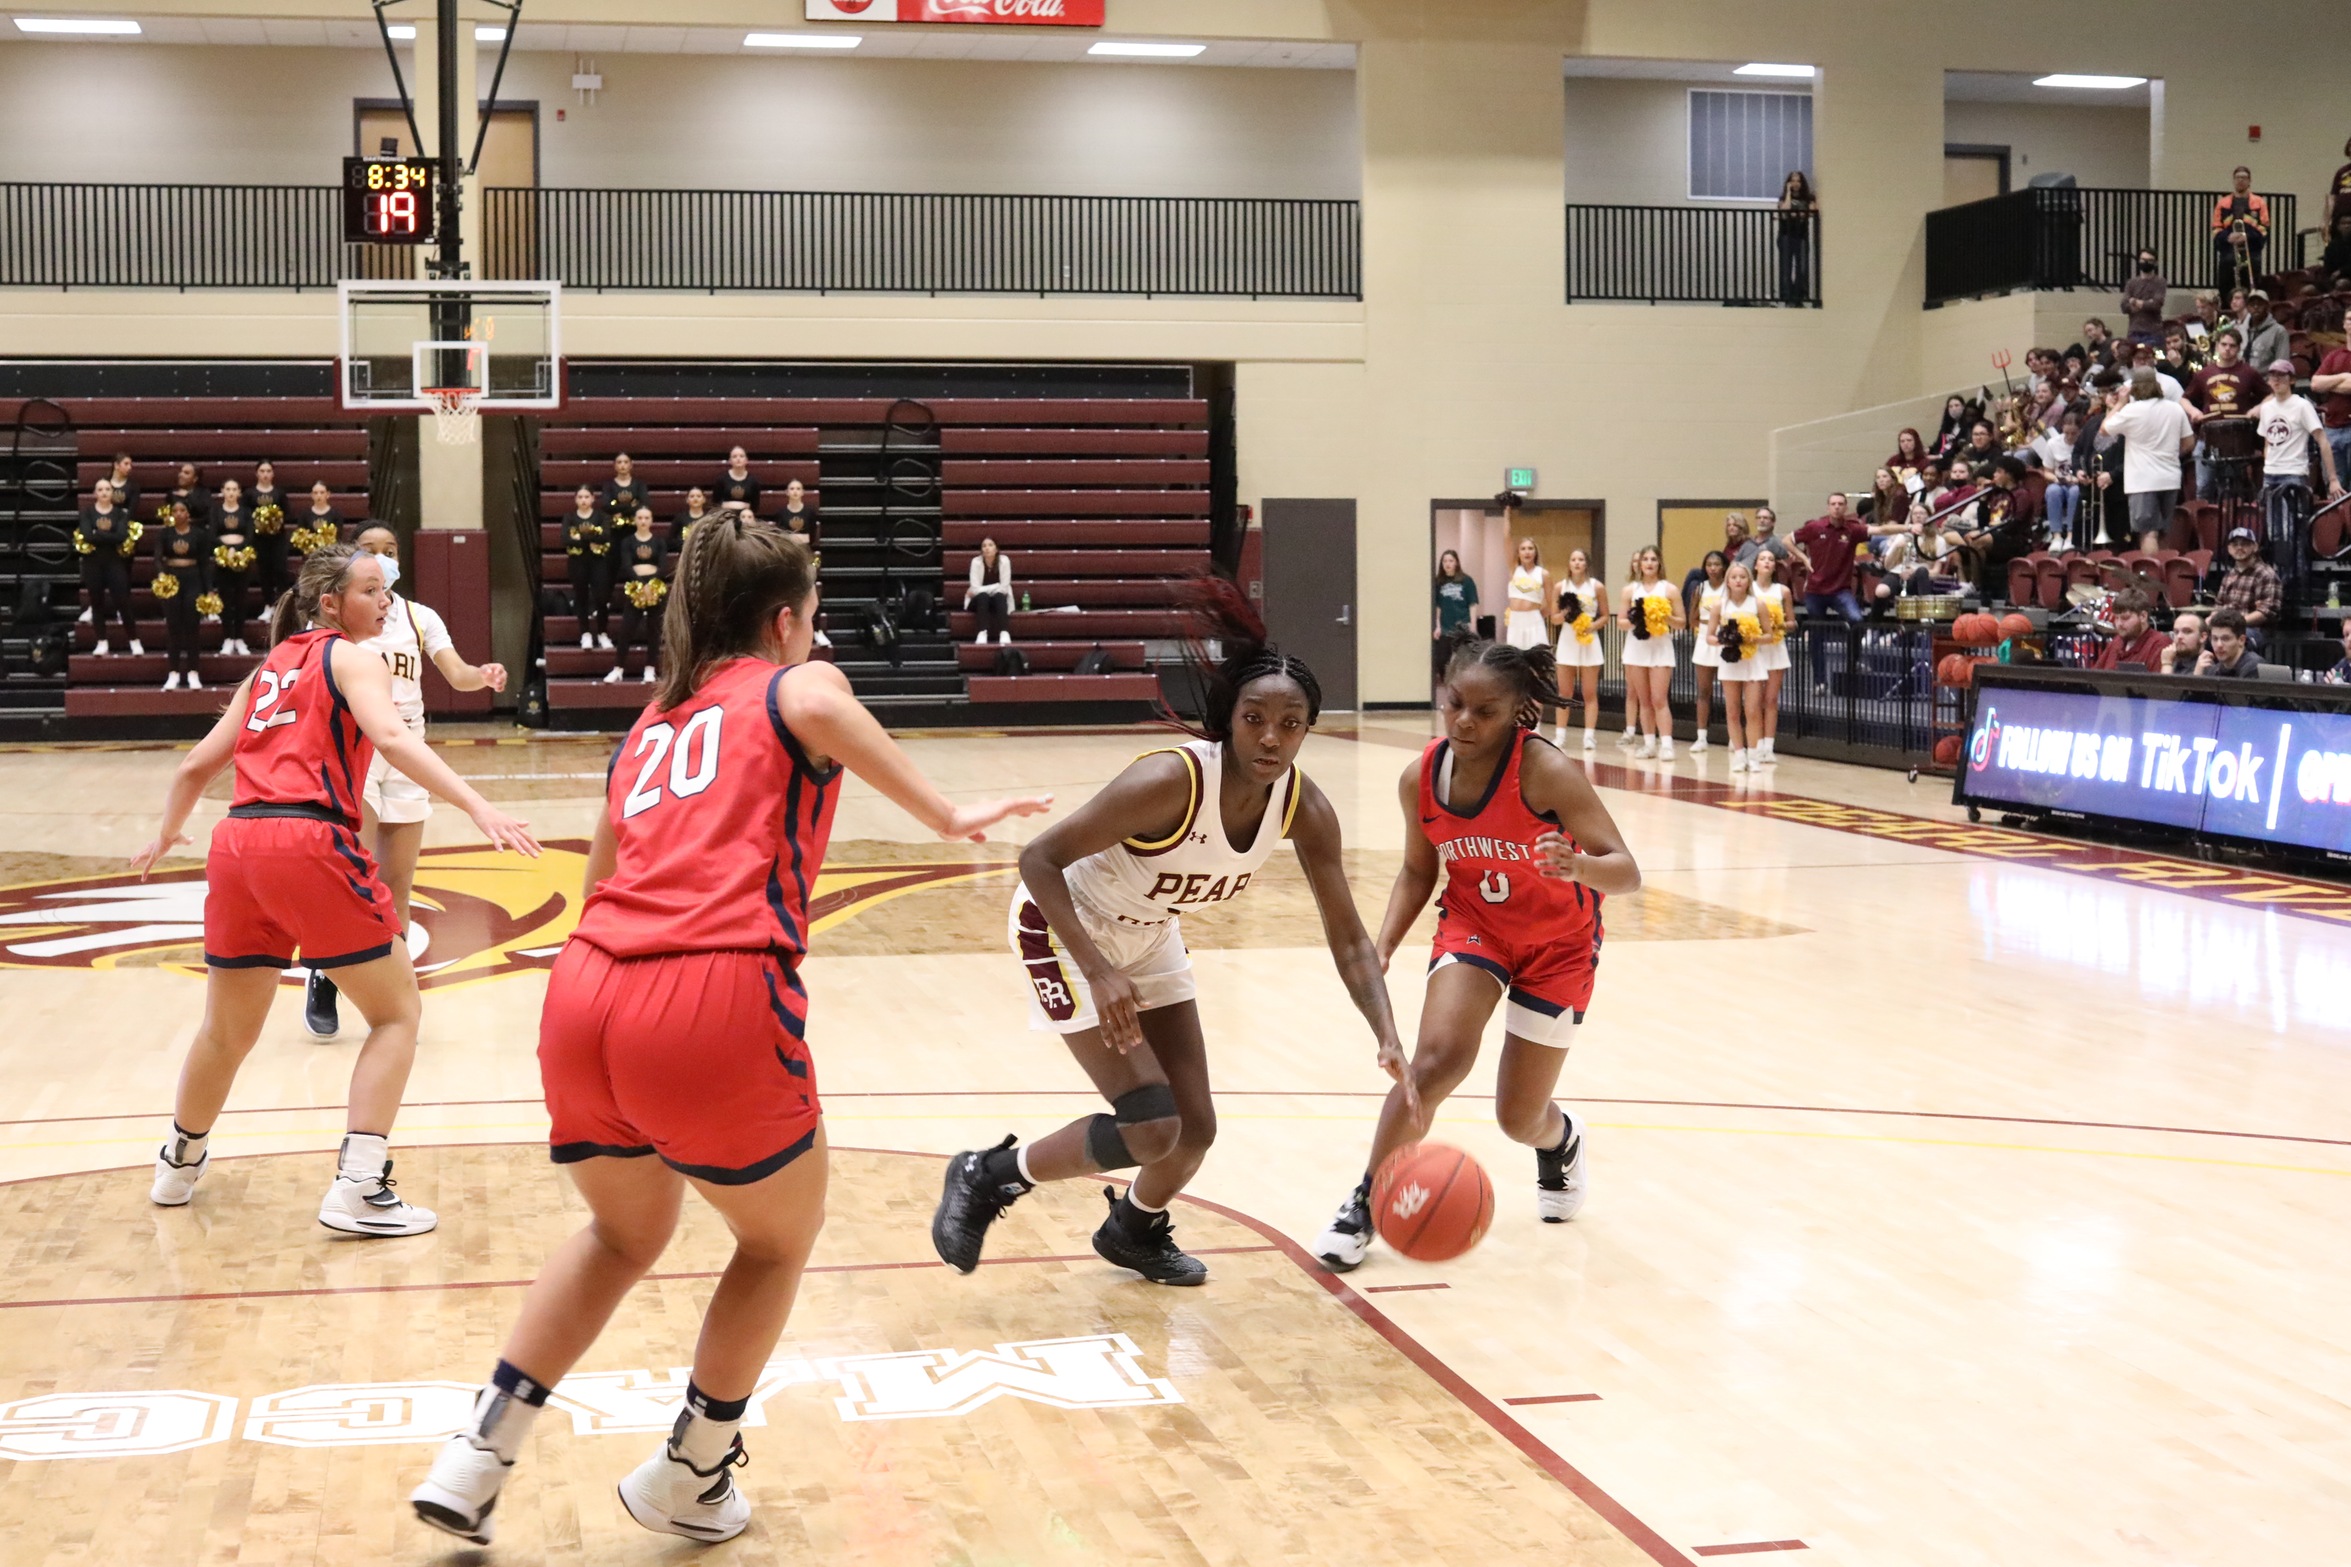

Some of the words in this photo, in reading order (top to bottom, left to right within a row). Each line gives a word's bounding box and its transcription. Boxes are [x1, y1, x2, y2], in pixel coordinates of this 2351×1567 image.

[368, 164, 426, 190] 8:34
[380, 192, 415, 233] 19
[1512, 469, 1532, 486] EXIT
[245, 668, 302, 732] 22
[622, 704, 725, 819] 20
[1999, 725, 2073, 775] FOLLOW
[2071, 733, 2101, 779] US
[2100, 735, 2133, 782] ON
[2140, 732, 2265, 803] TikTok
[1718, 797, 2090, 858] PEARL
[1143, 872, 1255, 905] PEAR
